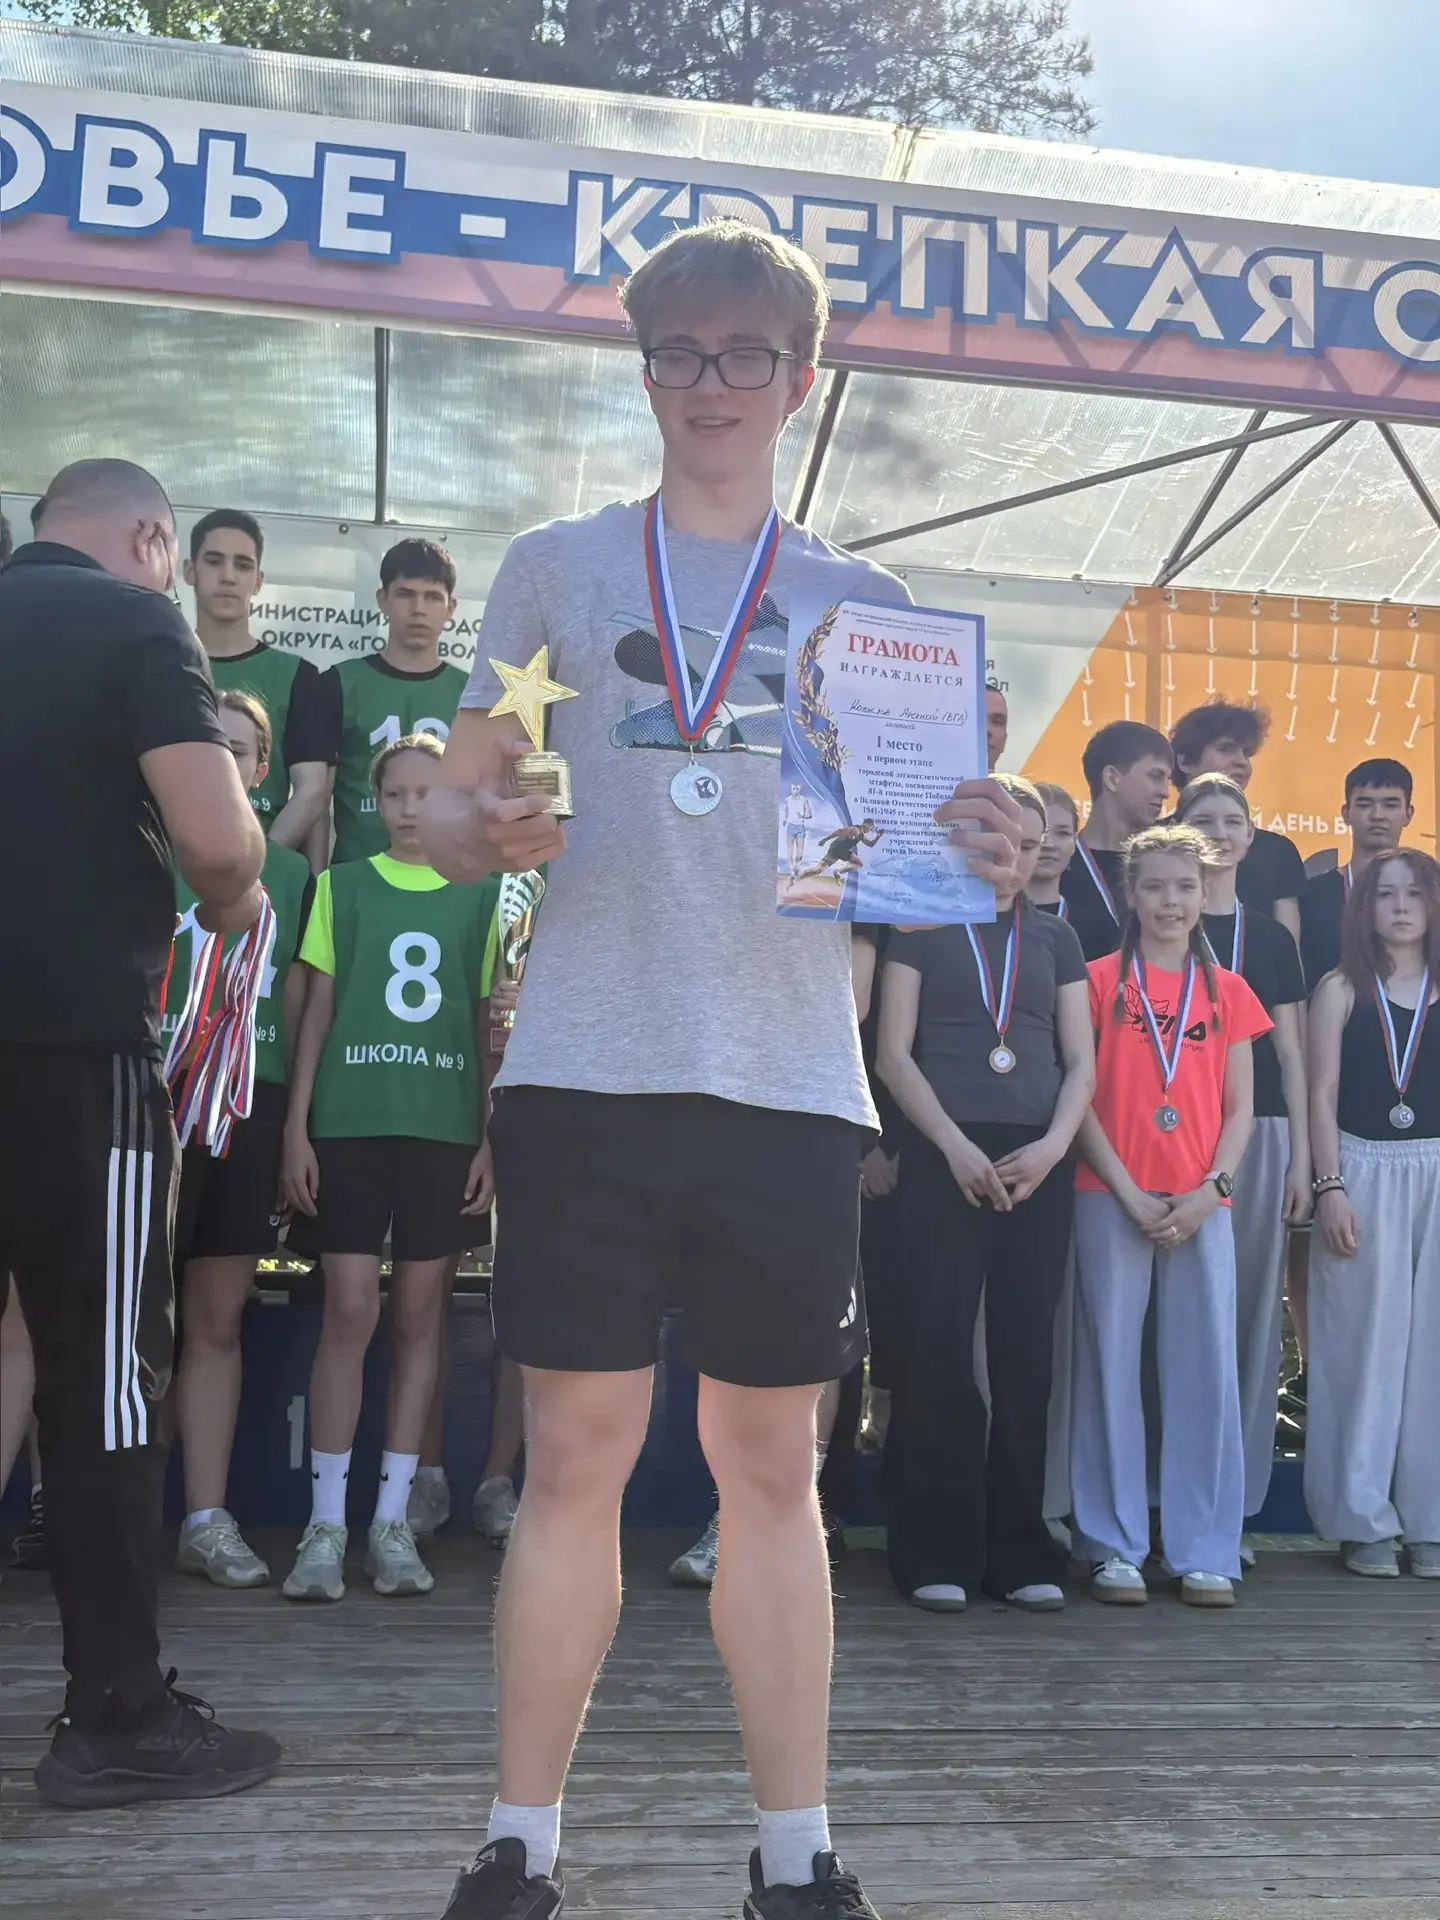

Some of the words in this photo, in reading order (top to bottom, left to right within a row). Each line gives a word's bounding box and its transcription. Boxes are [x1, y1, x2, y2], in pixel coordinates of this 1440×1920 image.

[261, 629, 344, 651] ОКРУГА
[847, 633, 960, 667] ГРАМОТА
[840, 662, 963, 686] НАГРАЖДАЕТСЯ
[886, 740, 923, 752] место
[874, 755, 907, 766] первом
[908, 758, 934, 767] этапе
[858, 768, 894, 778] городской
[862, 806, 897, 816] 1941-1945
[1268, 812, 1330, 835] ДЕНЬ
[385, 931, 442, 1023] 8
[268, 1024, 277, 1042] 9
[345, 1043, 430, 1066] ШКОЛА
[435, 1051, 455, 1069] №
[456, 1052, 466, 1071] 9
